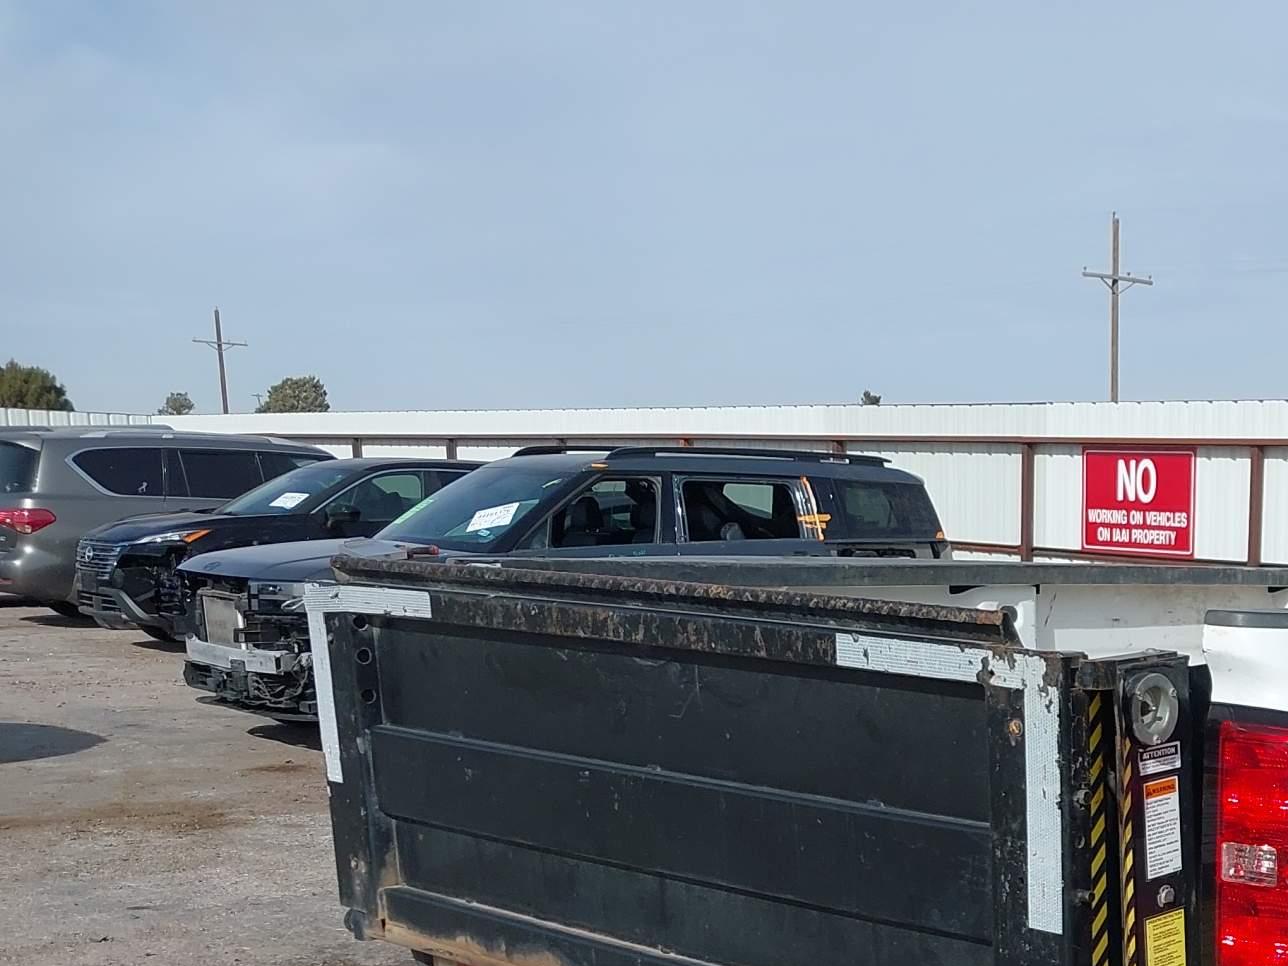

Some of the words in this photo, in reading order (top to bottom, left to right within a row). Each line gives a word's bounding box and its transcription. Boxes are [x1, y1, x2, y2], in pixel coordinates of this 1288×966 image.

[1116, 458, 1157, 503] NO
[1088, 508, 1128, 525] WORKING
[1129, 510, 1143, 525] ON
[1146, 512, 1188, 528] VEHICLES
[1097, 527, 1111, 542] ON
[1112, 528, 1130, 543] IAAI
[1131, 529, 1177, 545] PROPERTY
[1142, 746, 1176, 760] ATTENTION
